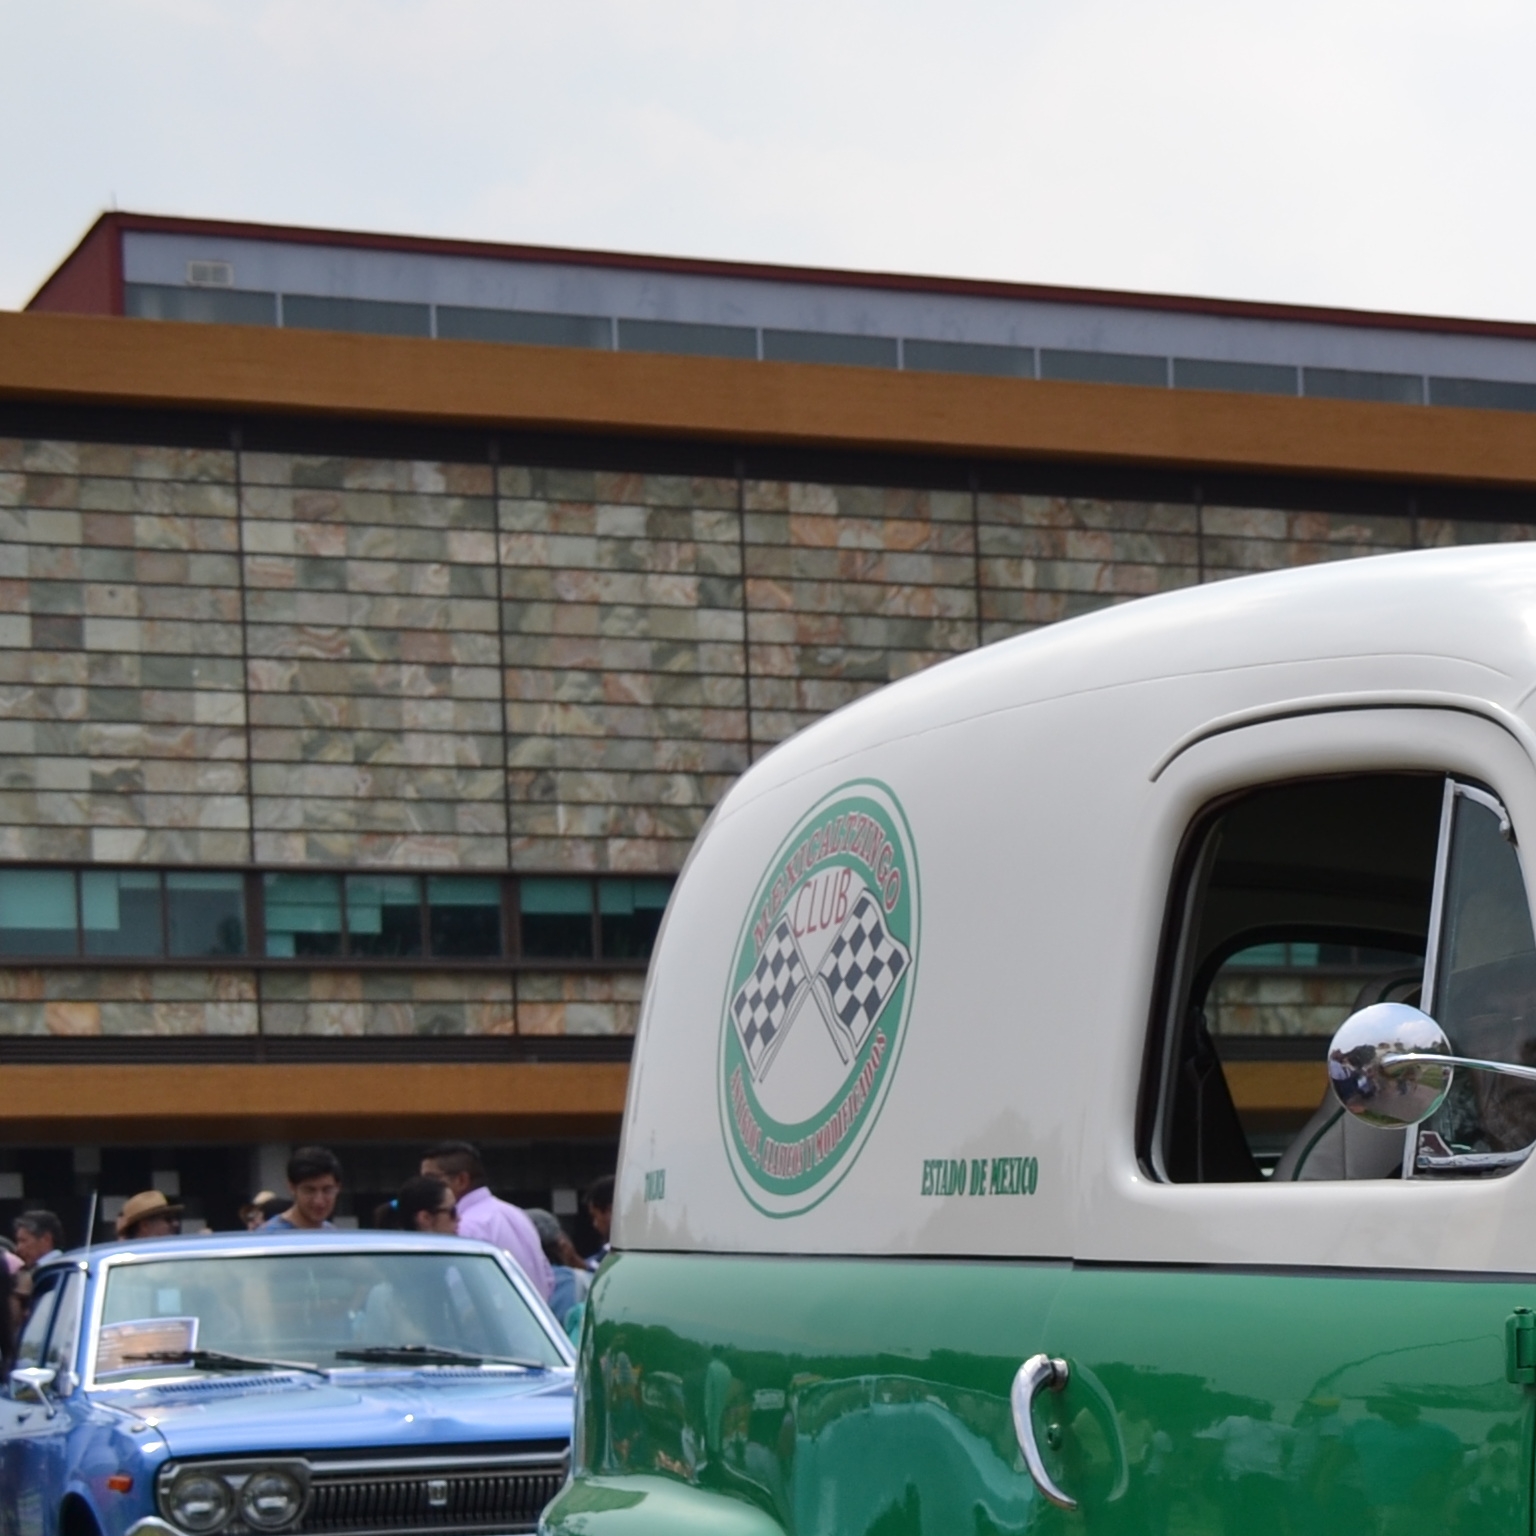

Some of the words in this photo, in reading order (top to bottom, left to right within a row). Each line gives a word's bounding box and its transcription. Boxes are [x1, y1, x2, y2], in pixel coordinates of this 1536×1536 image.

[794, 868, 852, 938] CLUB
[920, 1157, 967, 1196] ESTADO
[968, 1158, 988, 1196] DE
[988, 1156, 1039, 1196] MEXICO
